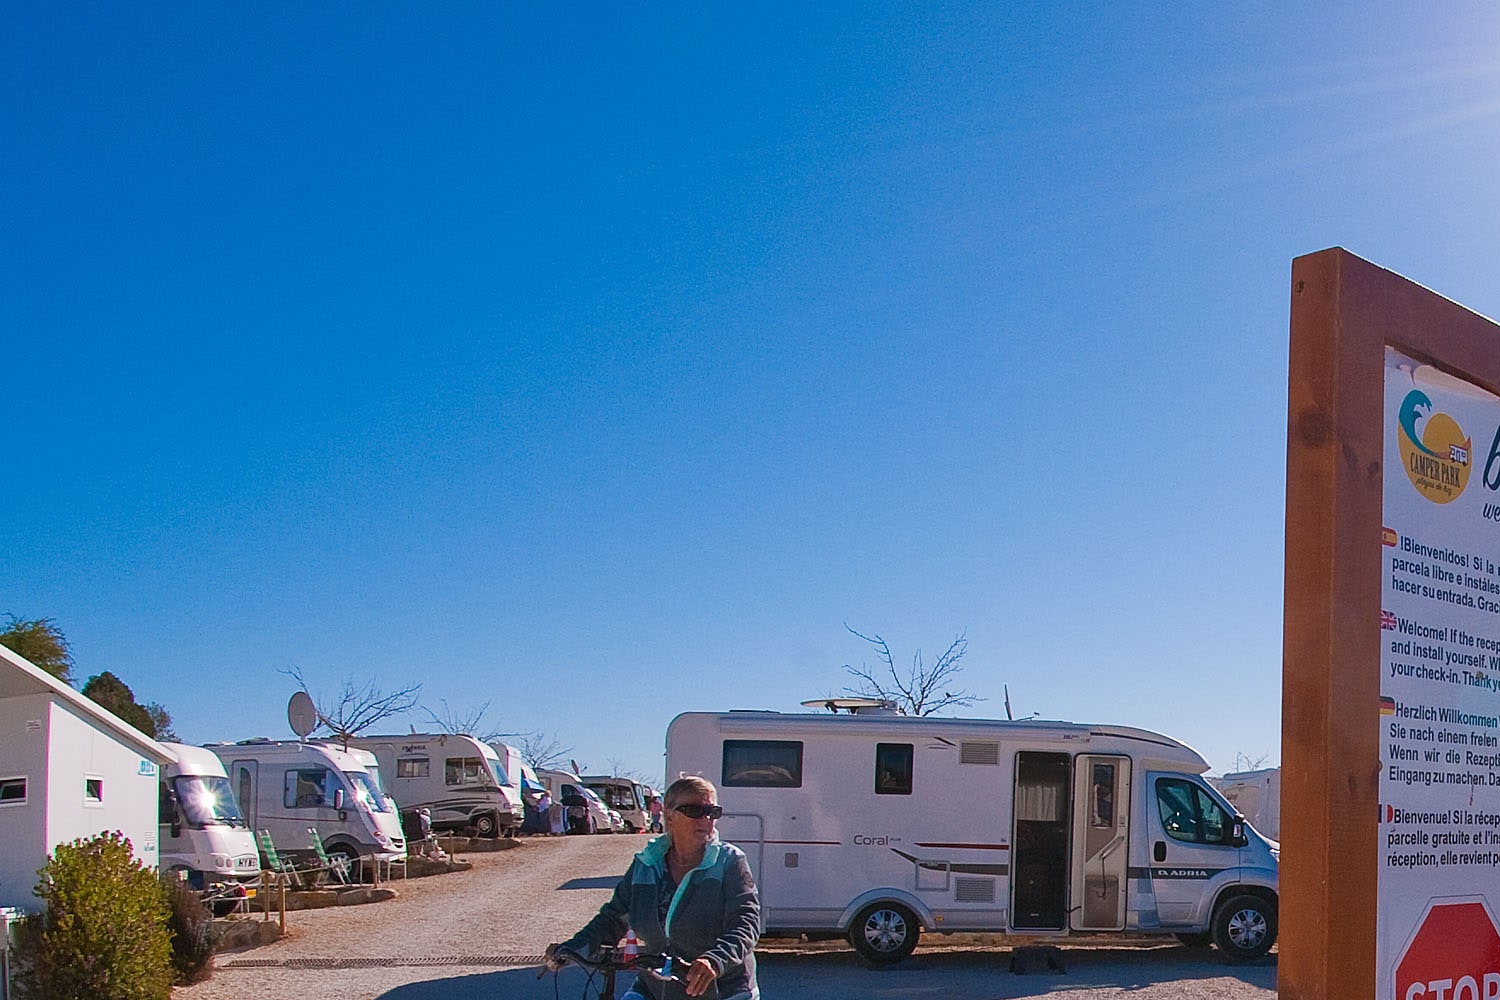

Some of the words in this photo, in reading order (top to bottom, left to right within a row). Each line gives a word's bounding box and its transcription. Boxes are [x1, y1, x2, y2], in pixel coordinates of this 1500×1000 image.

[1410, 452, 1440, 481] CAMPER
[1441, 462, 1461, 488] PARK
[1392, 557, 1429, 577] parcela
[1432, 565, 1454, 583] libre
[1456, 574, 1462, 585] e
[1473, 556, 1482, 571] Si
[1486, 560, 1494, 574] la
[1392, 575, 1421, 595] hacer
[1422, 585, 1435, 599] su
[1437, 589, 1476, 608] entrada.
[1398, 618, 1447, 641] Welcome!
[1451, 628, 1457, 643] If
[1459, 631, 1474, 646] the
[1391, 640, 1411, 655] and
[1413, 642, 1443, 661] install
[1445, 650, 1487, 669] yourself.
[1391, 662, 1415, 677] your
[1415, 663, 1461, 684] check-in.
[1462, 671, 1491, 689] Thank
[1395, 702, 1437, 722] Herzlich
[1438, 707, 1497, 729] Willkommen
[1390, 723, 1406, 739] Sie
[1409, 726, 1434, 742] nach
[1437, 728, 1467, 745] einem
[1470, 731, 1497, 747] freien
[1389, 744, 1418, 761] Wenn
[1424, 748, 1440, 762] wir
[1445, 749, 1460, 764] die
[1389, 766, 1432, 786] Eingang
[1433, 771, 1445, 784] zu
[1446, 771, 1488, 786] machen.
[1394, 808, 1451, 824] Bienvenue!
[1453, 809, 1463, 825] Si
[1465, 810, 1473, 825] la
[853, 834, 889, 846] Coral
[1387, 830, 1429, 849] parcelle
[1431, 830, 1470, 848] gratuite
[1472, 831, 1482, 845] et
[1387, 851, 1439, 869] réception,
[1440, 850, 1458, 865] elle
[1459, 850, 1492, 865] revient
[1170, 869, 1208, 877] ADRIA
